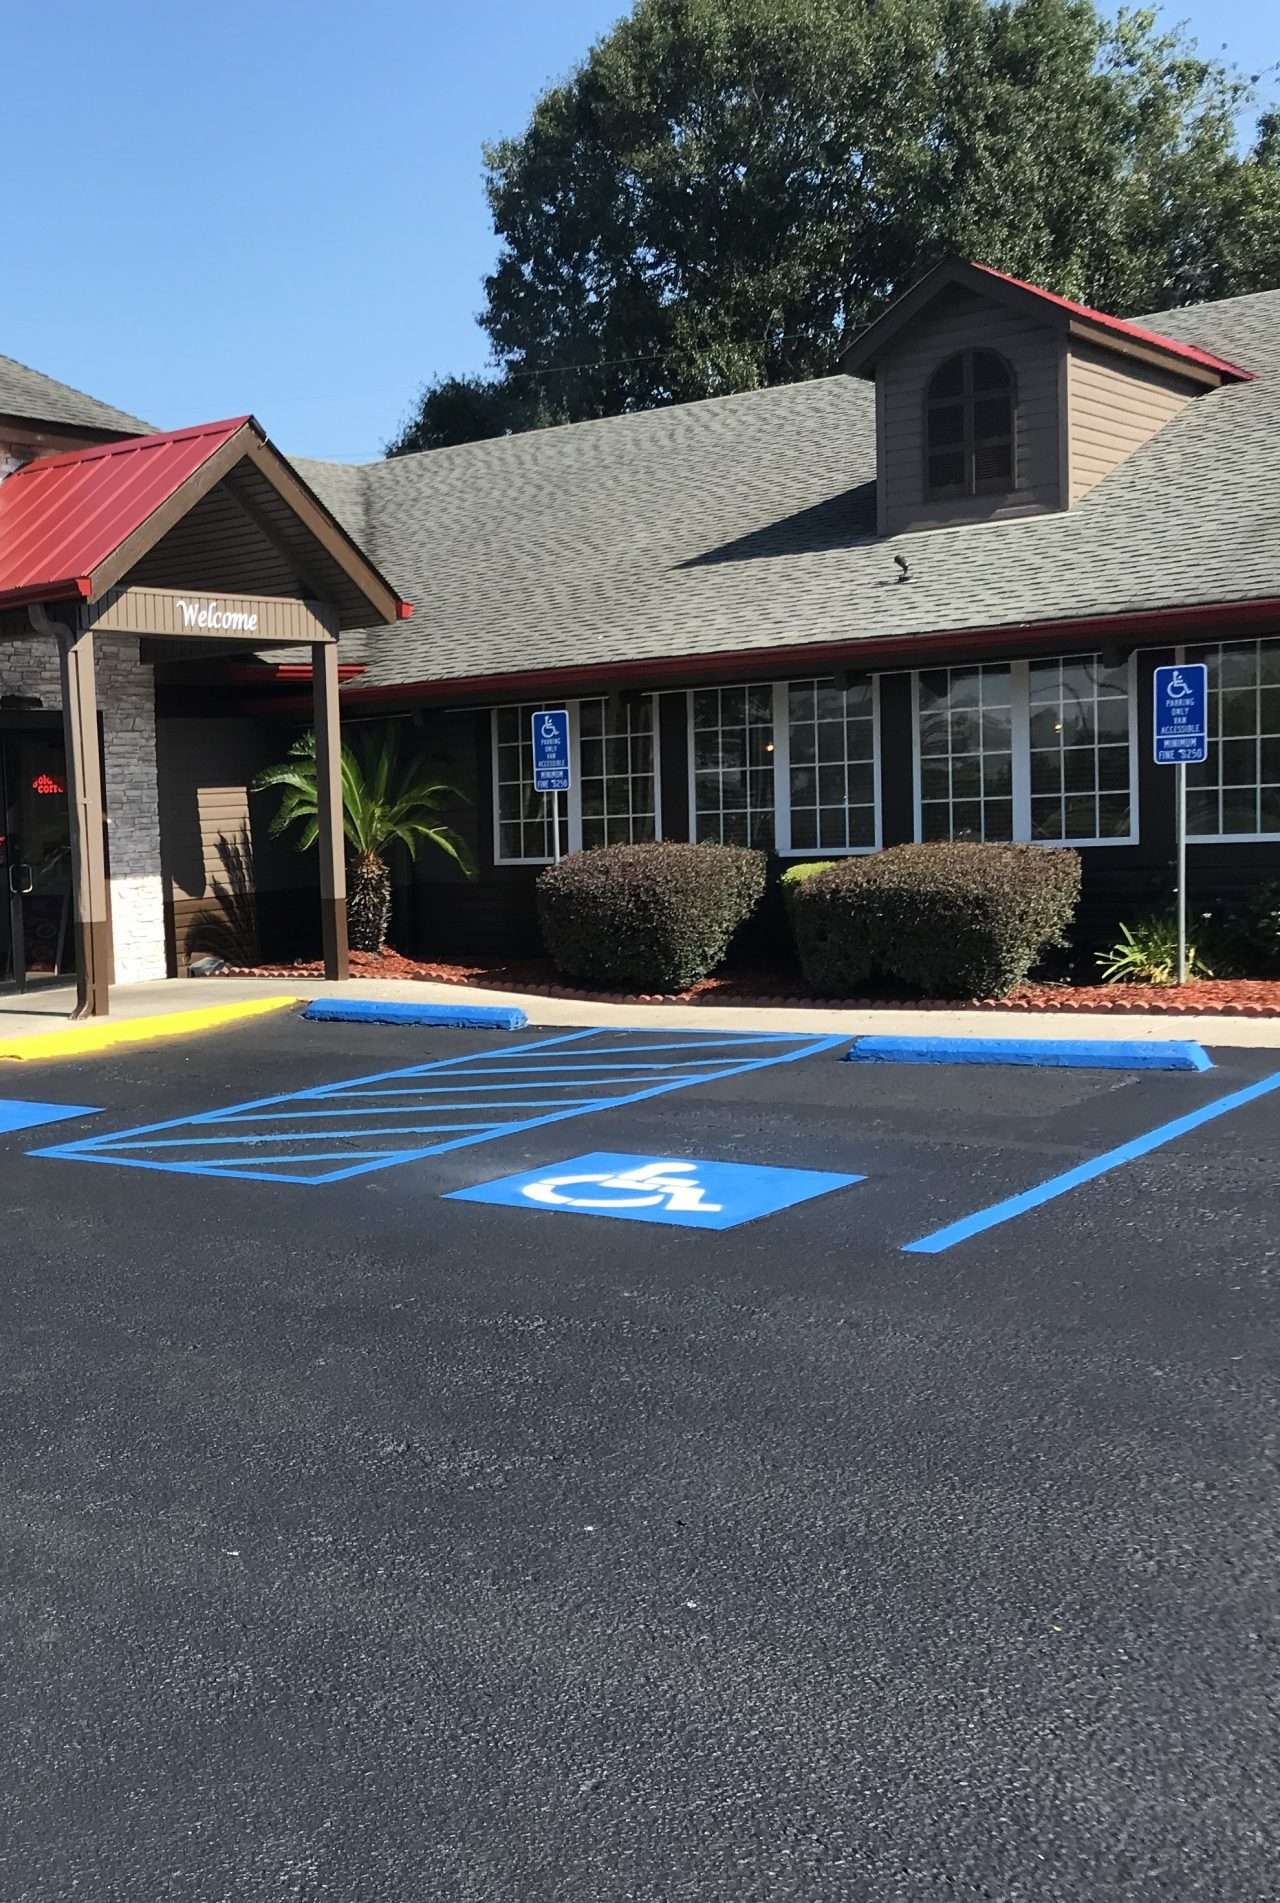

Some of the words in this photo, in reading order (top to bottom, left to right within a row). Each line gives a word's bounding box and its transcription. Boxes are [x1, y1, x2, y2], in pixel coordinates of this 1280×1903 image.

[176, 600, 258, 631] Welcome
[1166, 698, 1195, 707] PARKING
[1171, 707, 1189, 716] ONLY
[1173, 716, 1187, 725] VAN
[1160, 724, 1200, 734] ACCESSIBLE
[1163, 738, 1197, 749] MINIMUM
[1159, 750, 1175, 760] FINE
[1177, 748, 1202, 759] $250
